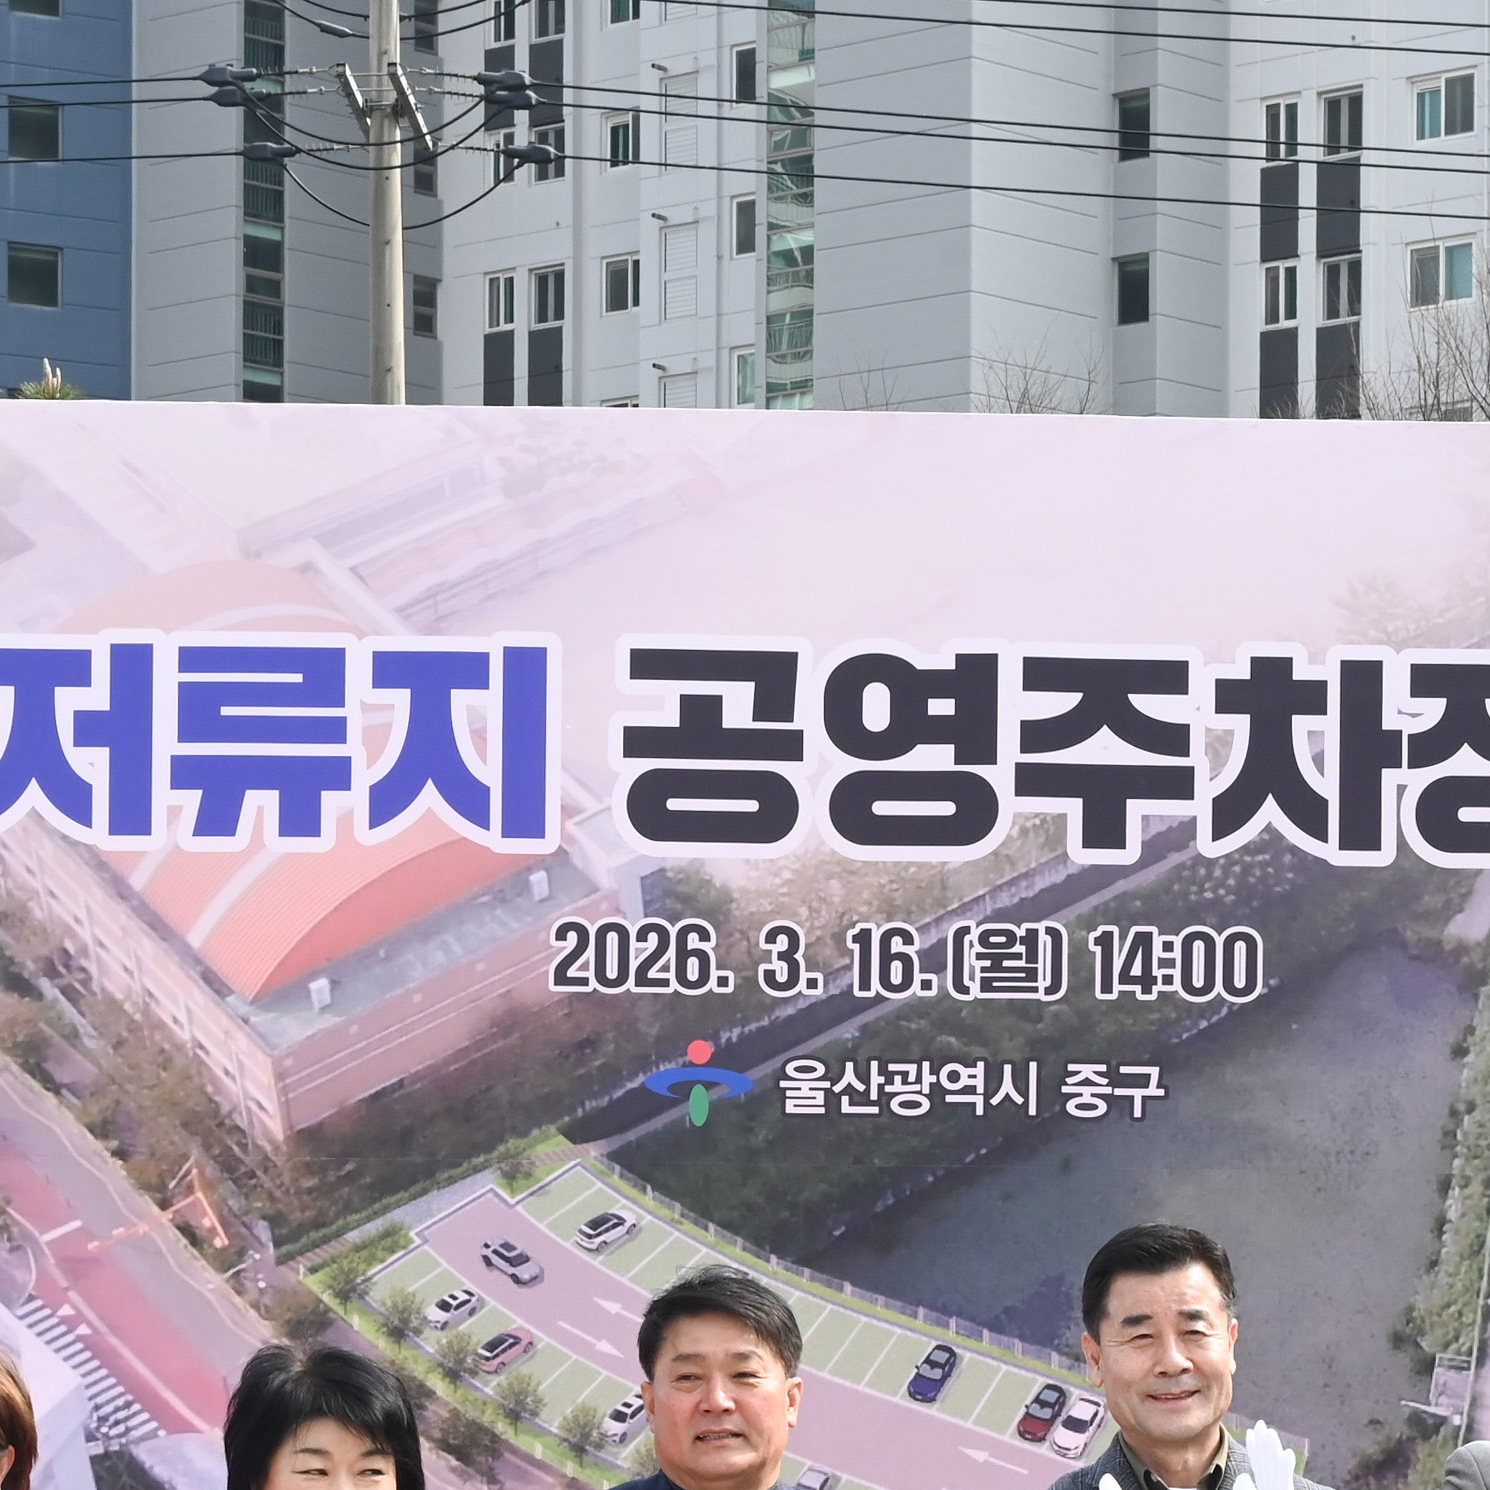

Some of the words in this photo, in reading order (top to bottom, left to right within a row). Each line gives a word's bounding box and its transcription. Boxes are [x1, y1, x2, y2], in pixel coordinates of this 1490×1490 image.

[550, 920, 733, 993] 2026.
[759, 922, 823, 994] 3.
[1090, 926, 1263, 1001] 14:00
[778, 1058, 1037, 1117] 울산광역시
[1060, 1062, 1166, 1119] 중구
